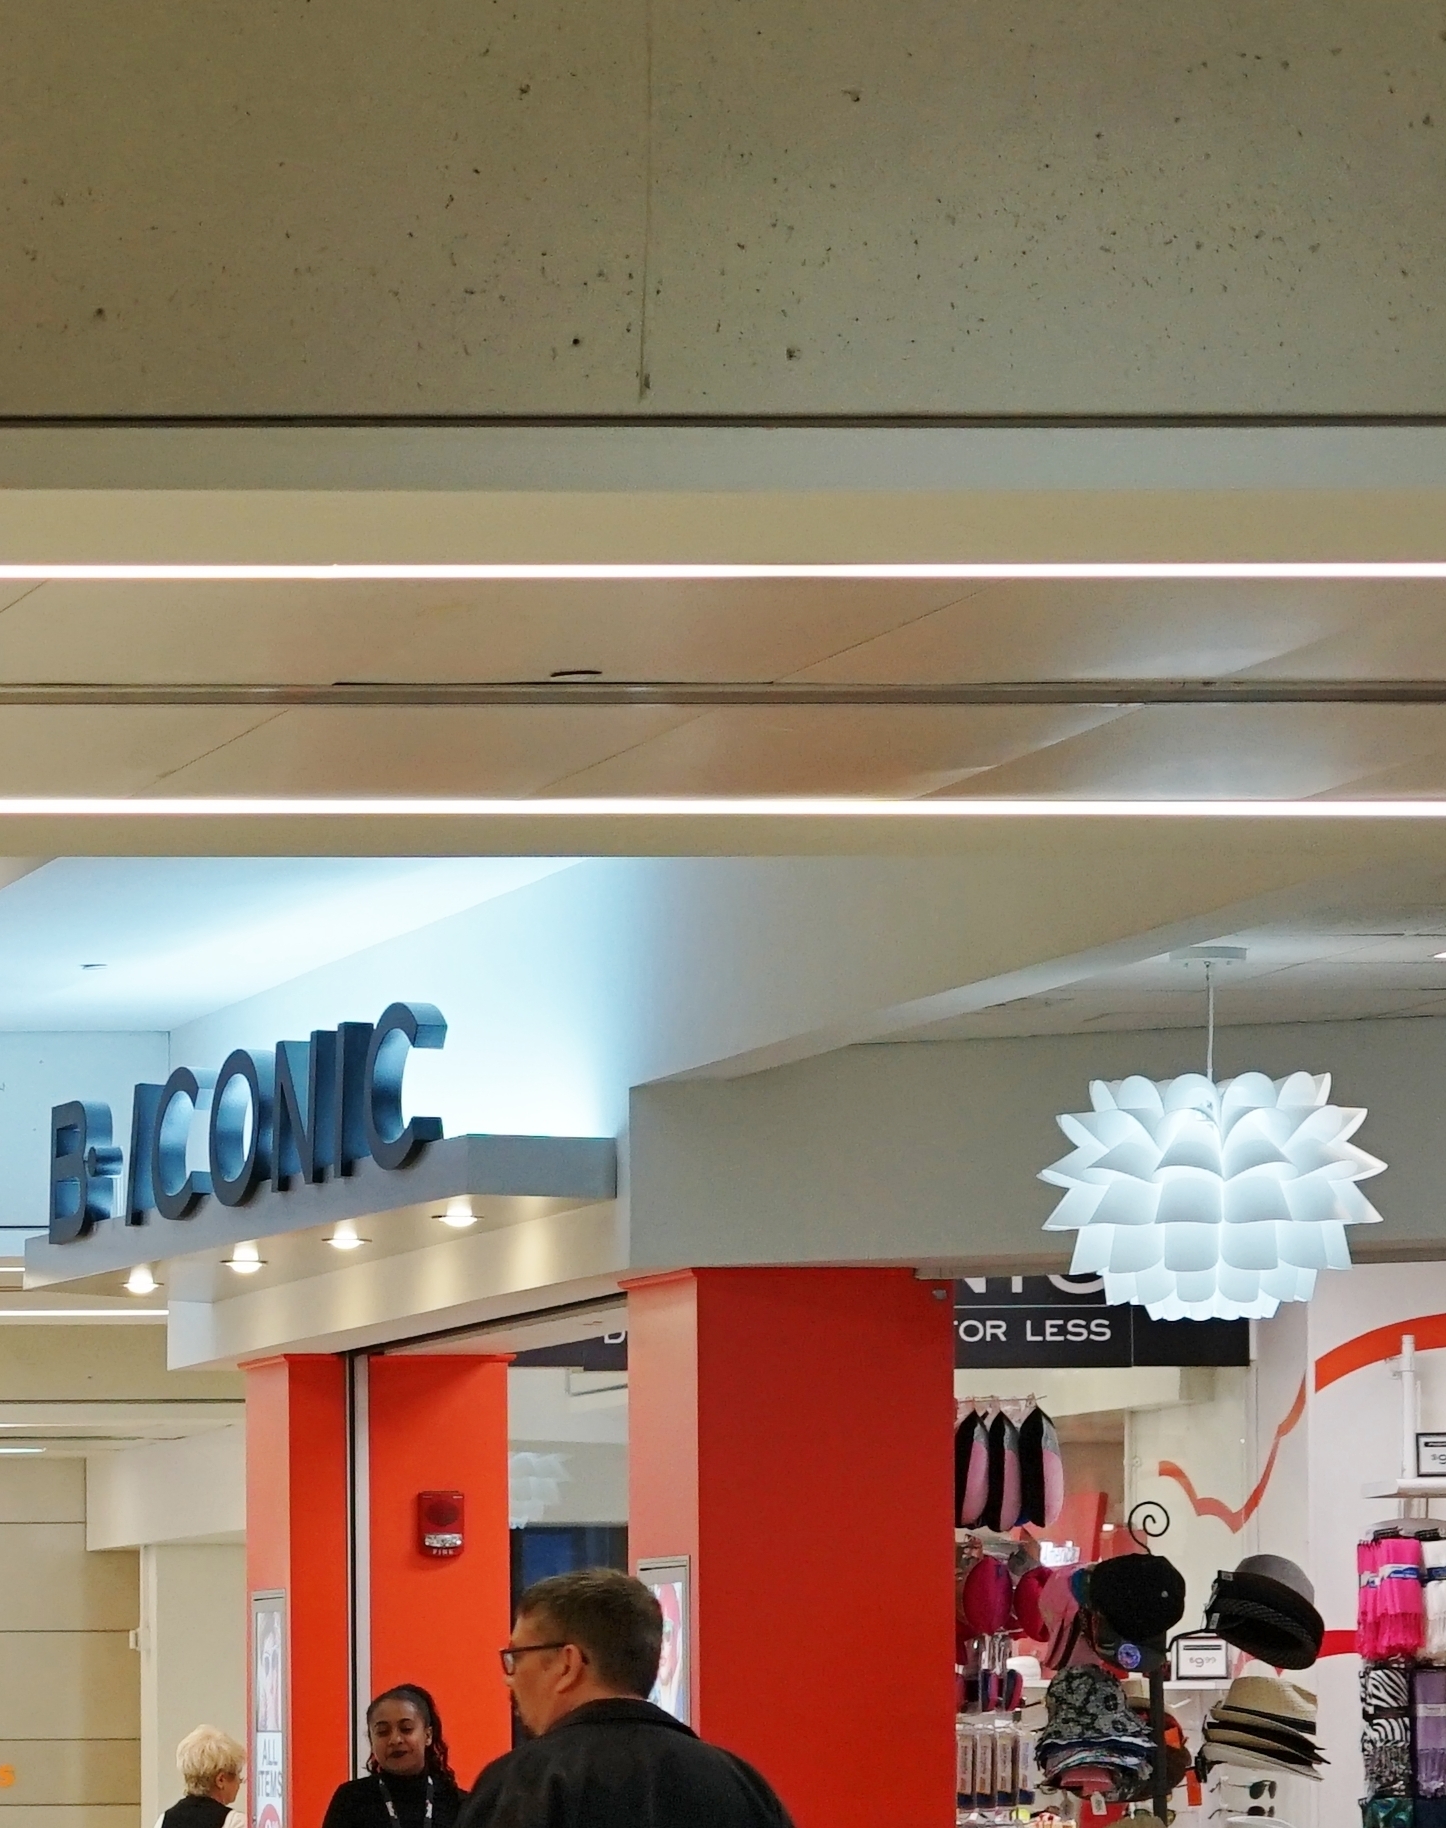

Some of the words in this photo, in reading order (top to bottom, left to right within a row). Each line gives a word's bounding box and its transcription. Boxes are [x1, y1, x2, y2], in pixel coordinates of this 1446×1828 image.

[954, 1320, 1006, 1342] OR
[1026, 1319, 1111, 1342] LESS
[263, 1739, 278, 1765] ALL
[258, 1770, 281, 1798] ITEMS
